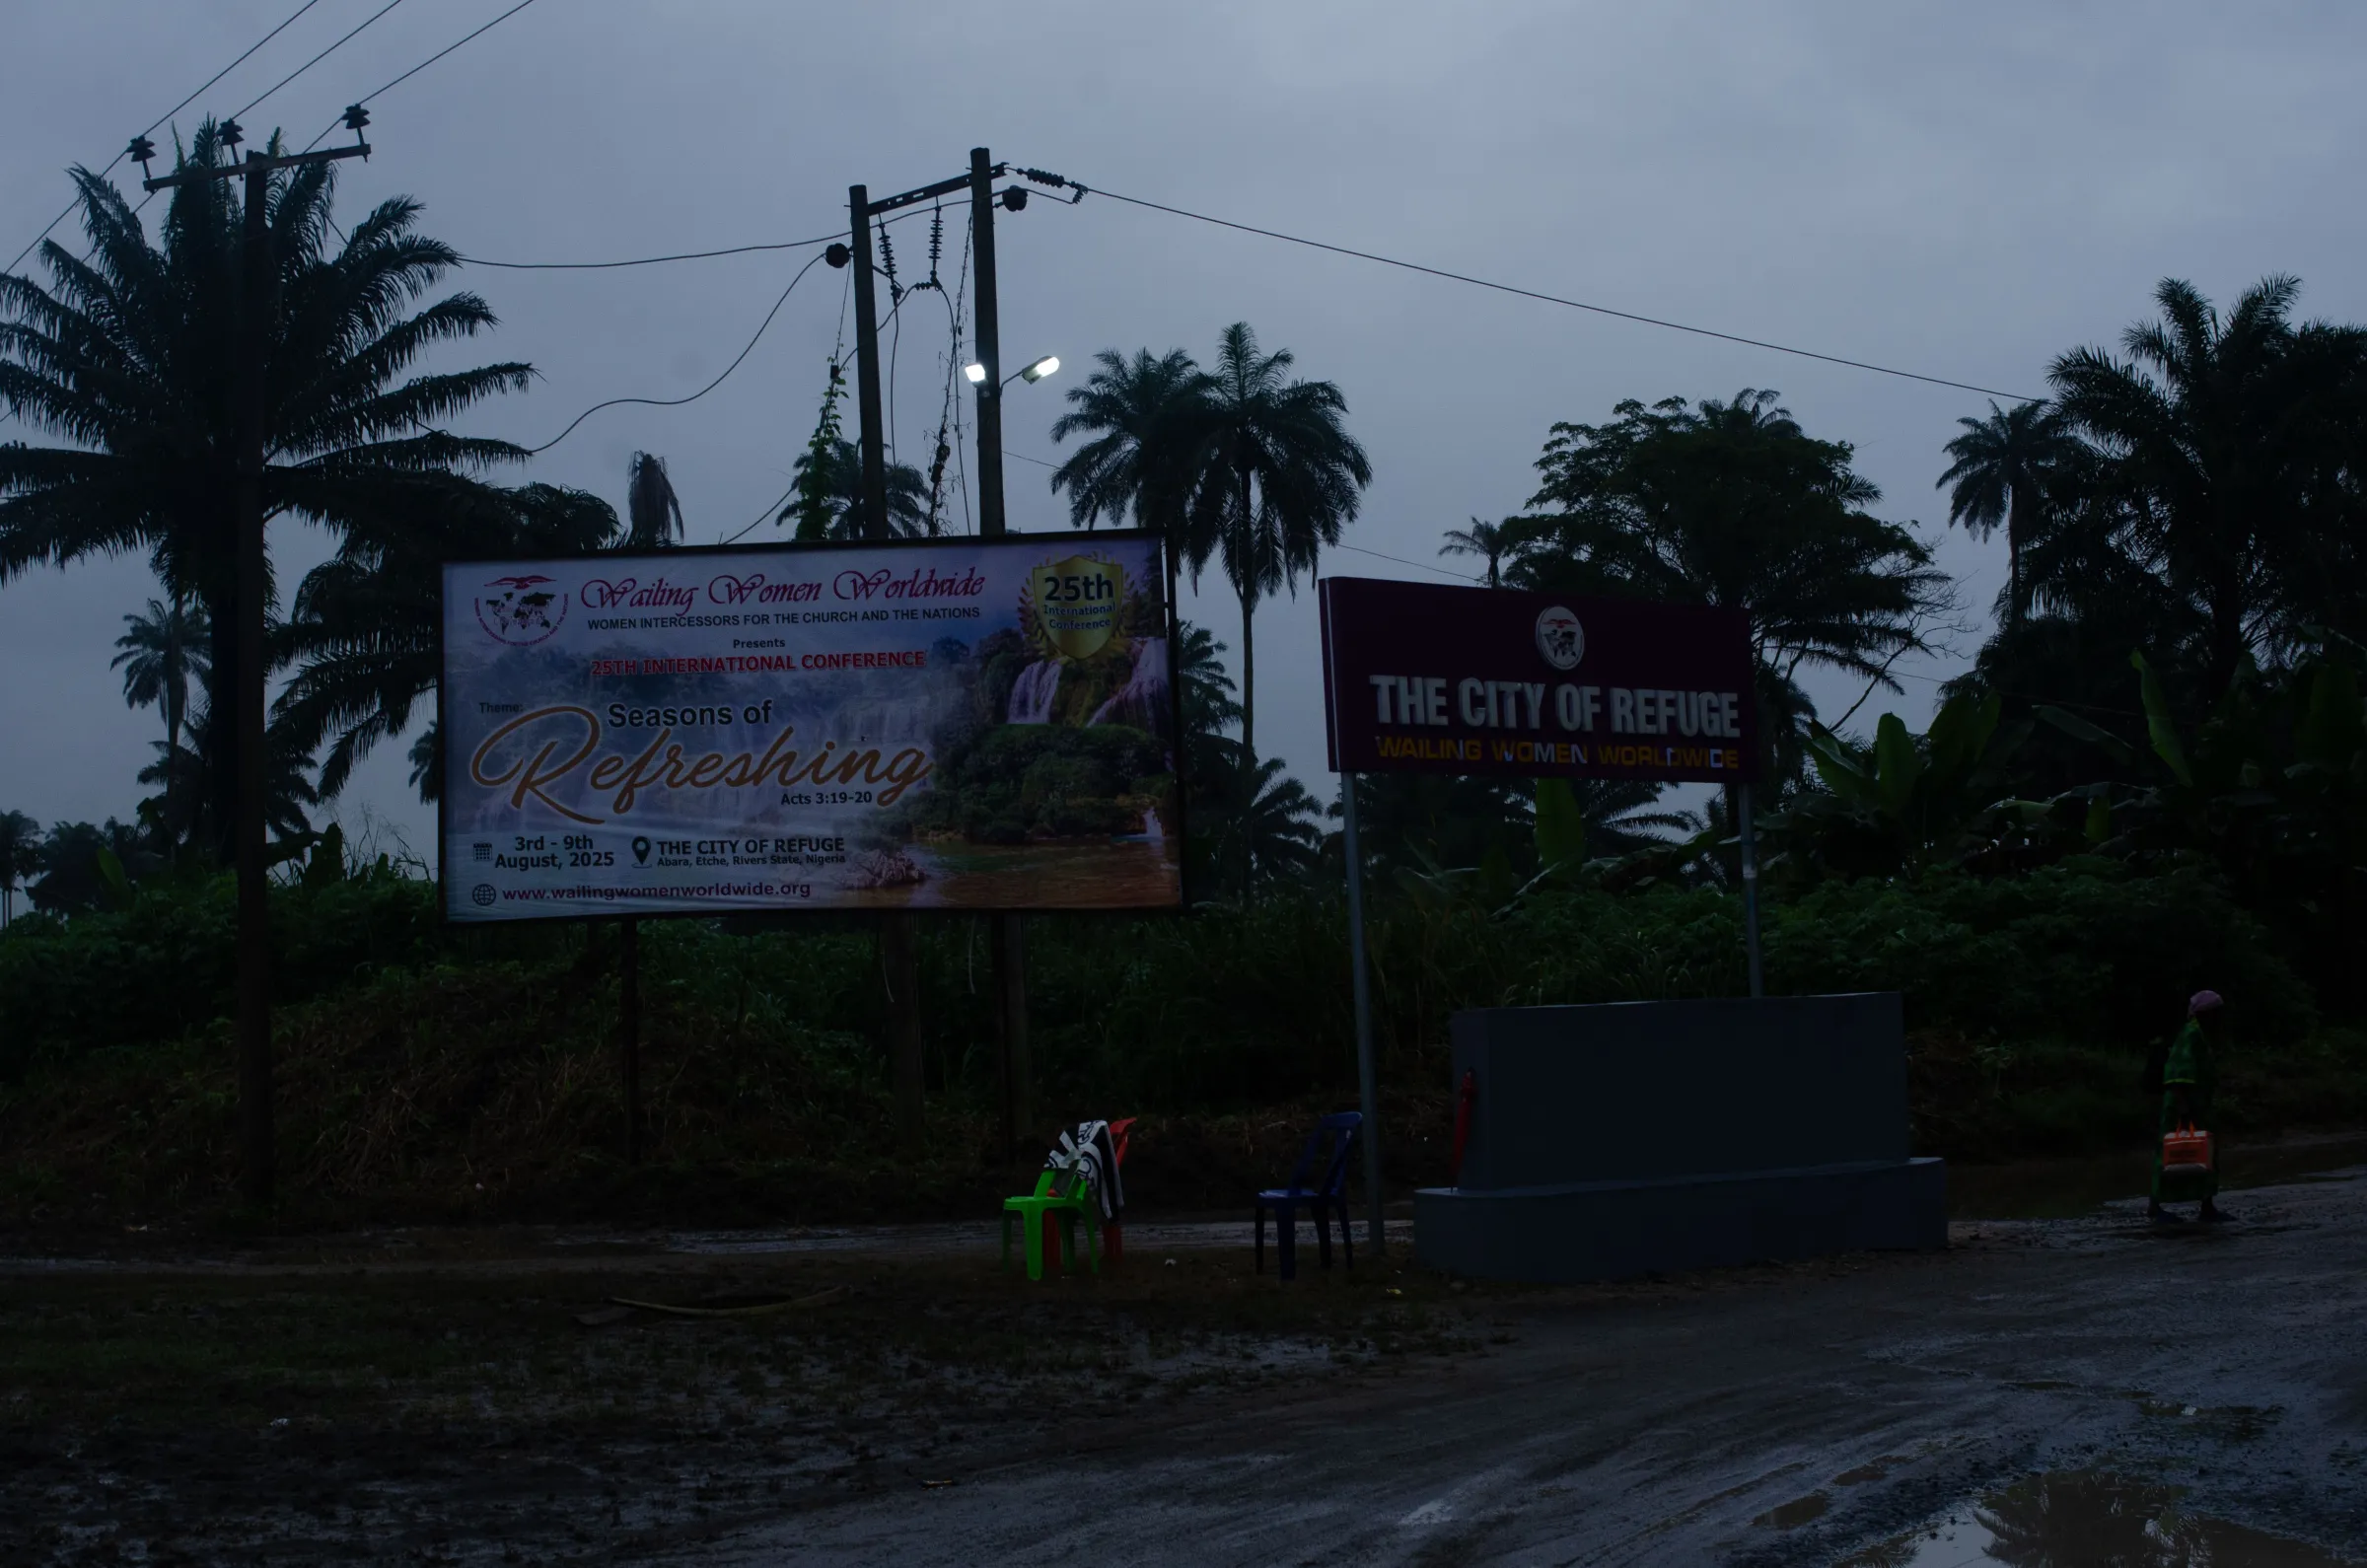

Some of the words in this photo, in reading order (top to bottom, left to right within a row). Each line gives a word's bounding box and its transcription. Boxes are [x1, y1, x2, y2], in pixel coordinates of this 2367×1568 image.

[580, 577, 699, 615] Wailing
[708, 573, 822, 605] Women
[833, 567, 984, 601] Worldwide
[1044, 573, 1113, 602] 25th
[588, 617, 637, 630] WOMEN
[640, 614, 740, 628] INTERCESSORS
[744, 613, 771, 625] FOR
[774, 612, 800, 624] THE
[803, 611, 857, 623] CHURCH
[861, 609, 889, 621] AND
[893, 608, 918, 621] THE
[922, 606, 980, 619] NATIONS
[1043, 602, 1116, 615] International
[1048, 618, 1111, 630] Conference
[733, 638, 785, 648] Presents
[592, 660, 637, 676] 25TH
[644, 655, 796, 674] INTERNATIONAL
[802, 651, 926, 670] CONFERENCE
[479, 702, 524, 713] Theme:
[608, 703, 733, 728] Seasons
[744, 700, 772, 724] of
[1370, 675, 1449, 726] THE
[1458, 677, 1546, 730] CITY
[1555, 683, 1601, 733] OF
[1610, 687, 1741, 739] REFUGE
[1375, 736, 1481, 761] WAILING
[1491, 740, 1589, 764] WOMEN
[1598, 747, 1740, 769] WORLDWIDE
[471, 705, 934, 824] Refreshing
[781, 793, 811, 805] Acts
[816, 790, 872, 805] 3:19-20
[515, 837, 544, 851] 3rd
[563, 835, 593, 850] 9th
[657, 840, 690, 855] THE
[697, 839, 739, 854] CITY
[745, 838, 767, 853] OF
[775, 837, 844, 853] REFUGE
[495, 852, 562, 871] August,
[569, 851, 614, 867] 2025
[657, 857, 690, 868] Abara,
[696, 856, 729, 867] Etche,
[733, 855, 766, 866] Rivers
[770, 854, 802, 865] State,
[806, 853, 846, 865] Nigeria
[502, 883, 811, 901] www.wailingwomenworldwide.org
